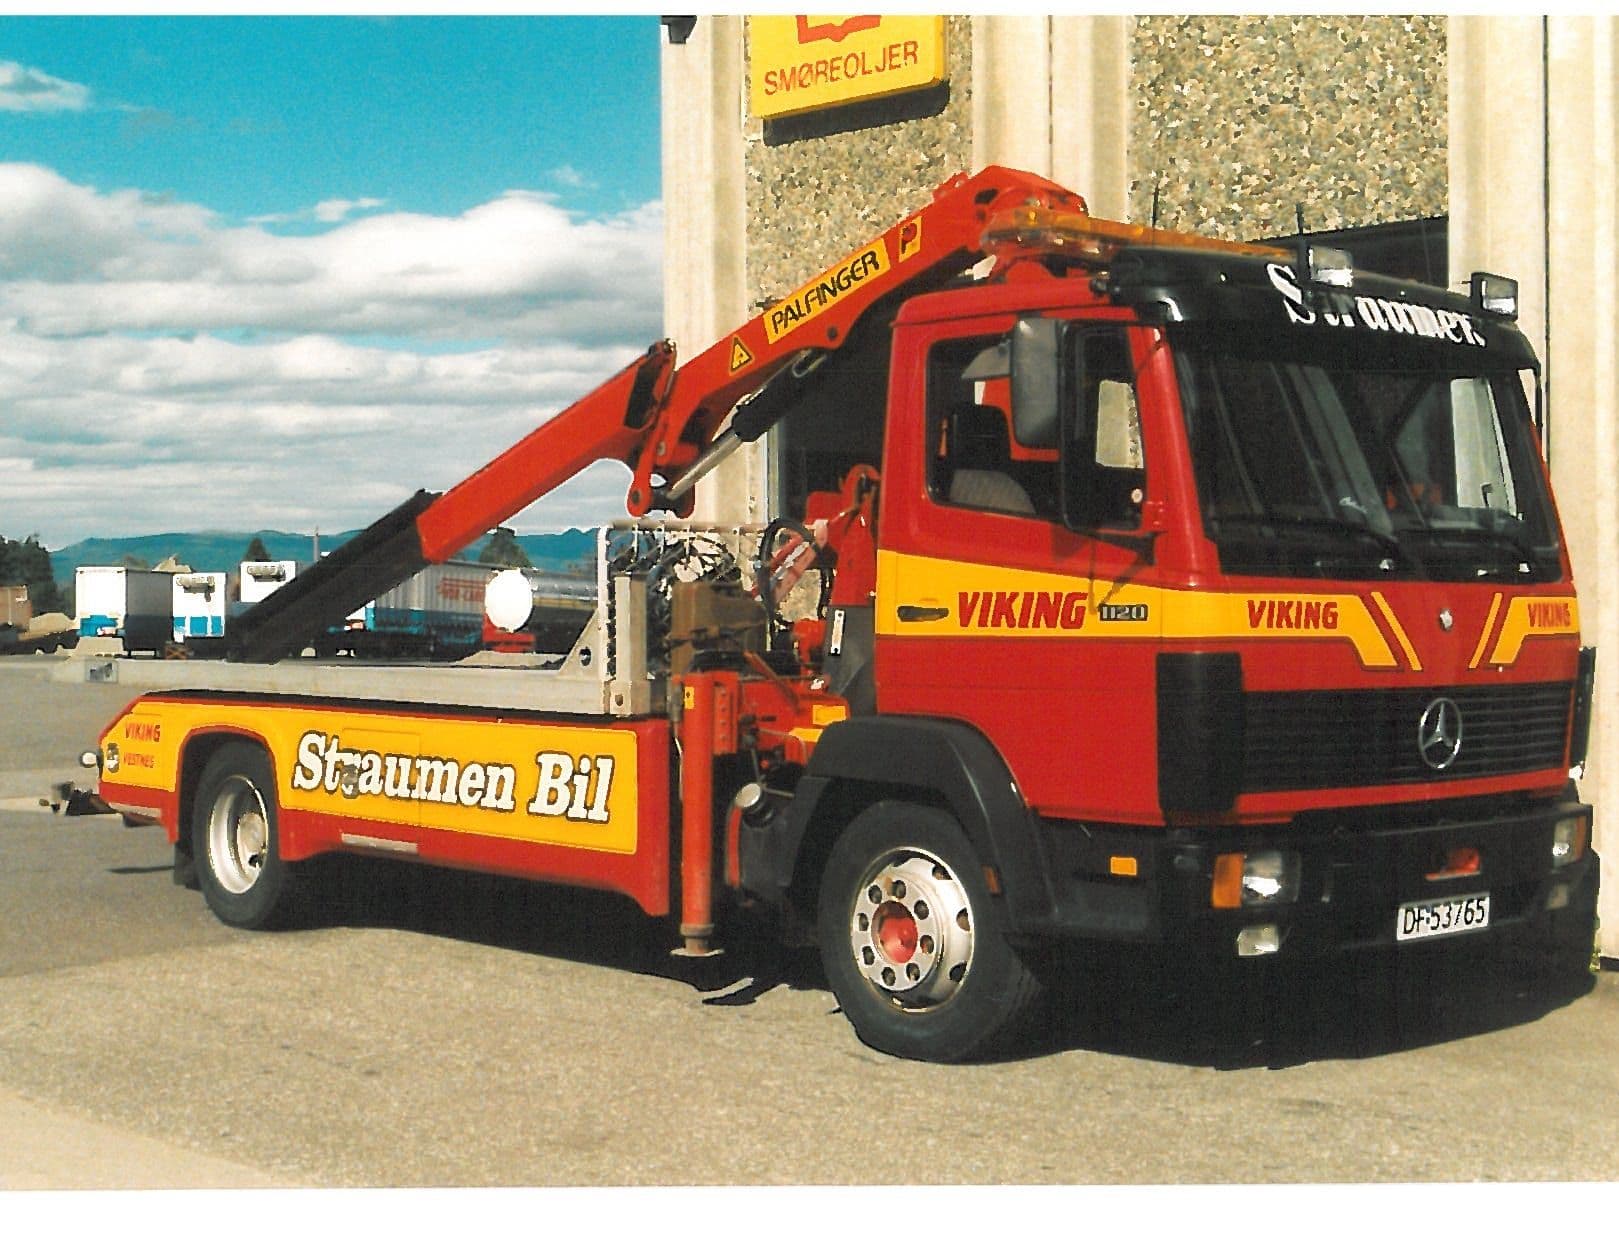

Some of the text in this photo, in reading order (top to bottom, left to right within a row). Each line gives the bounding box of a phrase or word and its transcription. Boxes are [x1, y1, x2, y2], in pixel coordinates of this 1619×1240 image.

[764, 40, 919, 96] SMØREOLJER
[771, 250, 880, 335] PALFINGER
[958, 592, 1146, 629] VIKING 1120
[1247, 600, 1339, 629] VIKING
[1528, 602, 1571, 627] VIKING
[125, 723, 161, 742] VIKING
[292, 730, 615, 823] Straumen Bil
